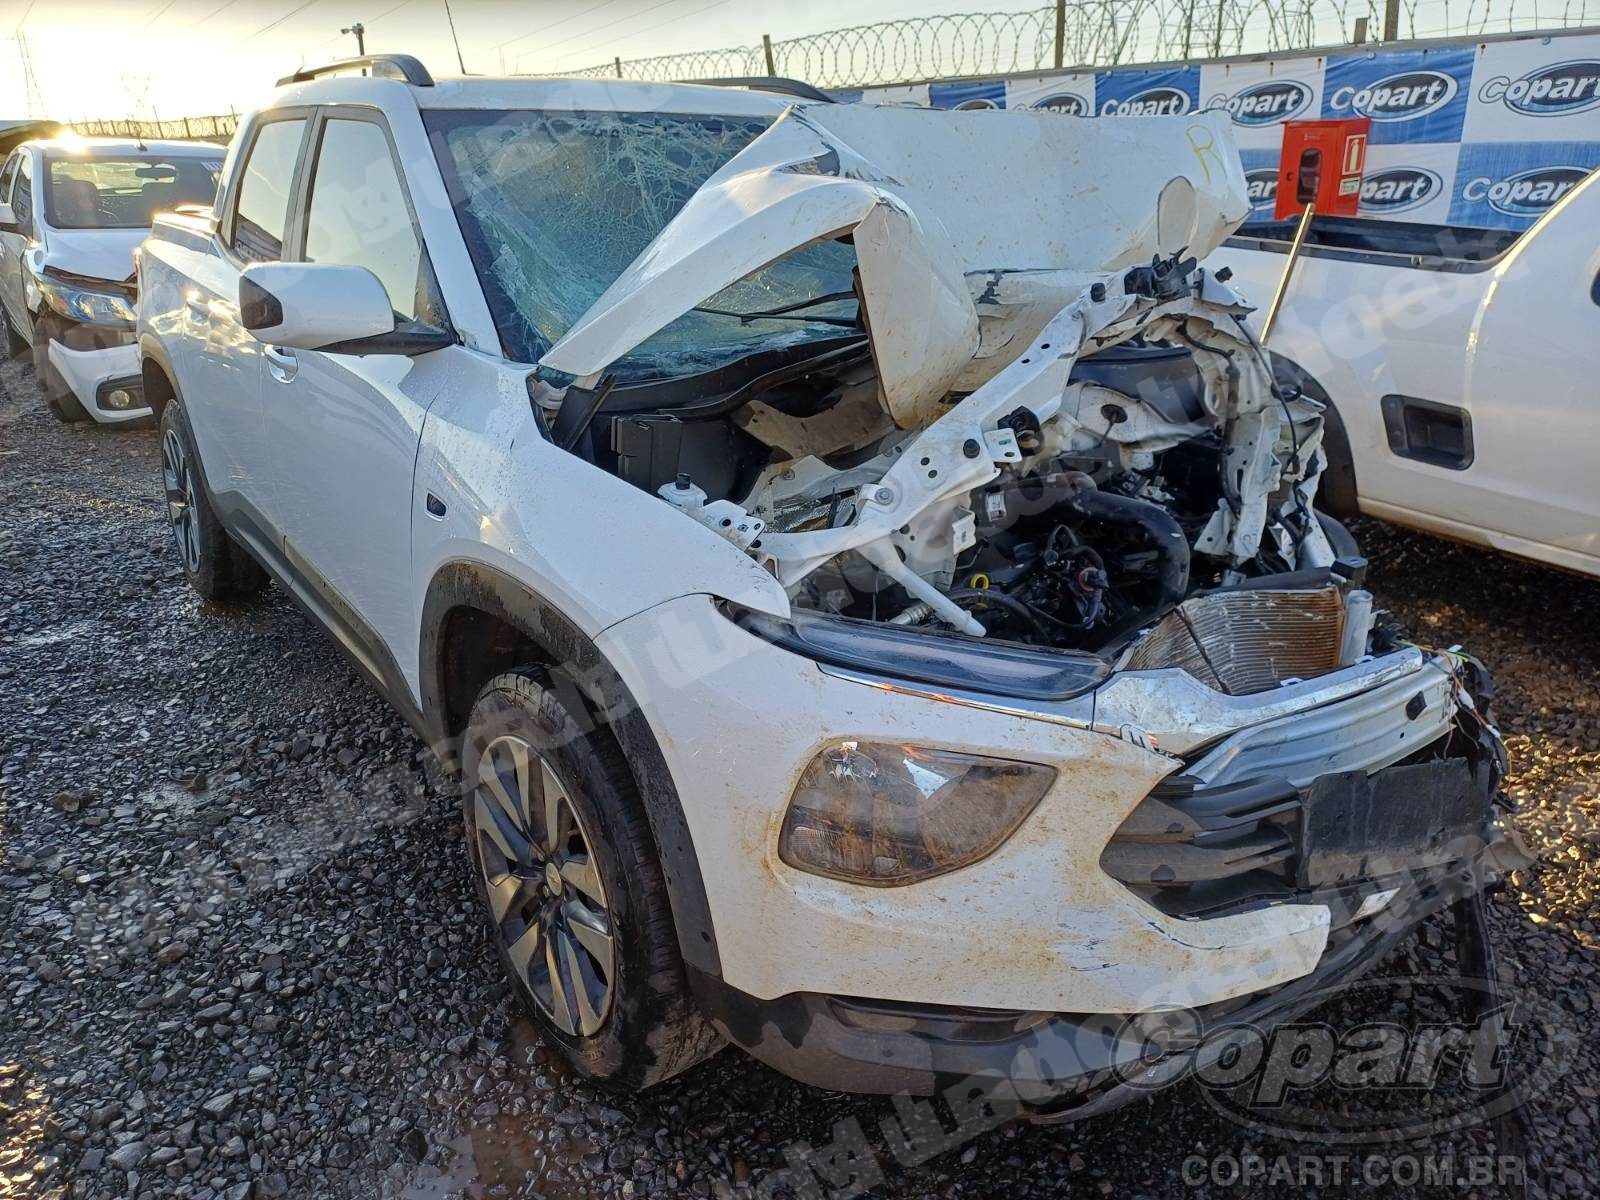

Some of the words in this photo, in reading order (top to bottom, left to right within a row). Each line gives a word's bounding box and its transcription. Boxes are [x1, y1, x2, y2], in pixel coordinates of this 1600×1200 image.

[1101, 95, 1180, 117] Copart
[1330, 80, 1442, 113] Copart
[1360, 176, 1427, 201] part
[1462, 177, 1577, 207] Copar
